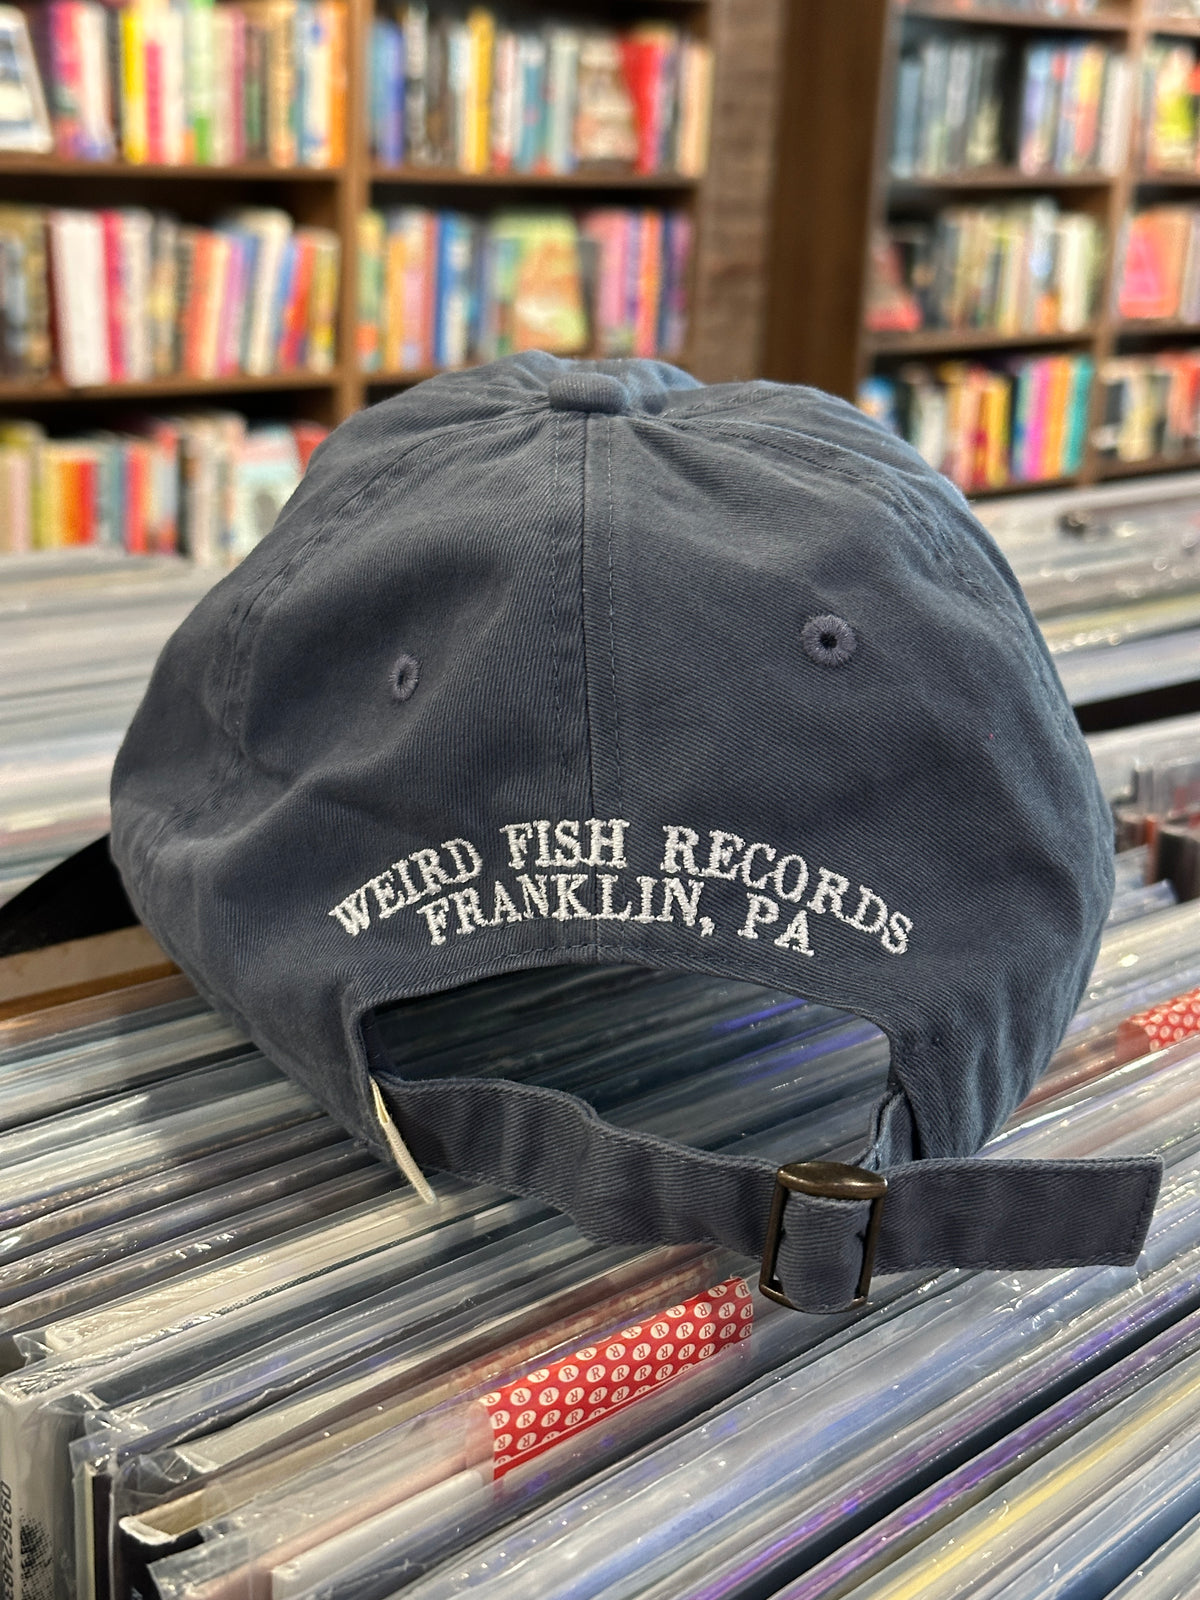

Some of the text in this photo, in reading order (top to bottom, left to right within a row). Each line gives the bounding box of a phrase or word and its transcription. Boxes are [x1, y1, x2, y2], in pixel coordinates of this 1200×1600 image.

[328, 817, 914, 954] WEIRD FISH RECORDS
[416, 873, 815, 957] FRANKLIN, PA
